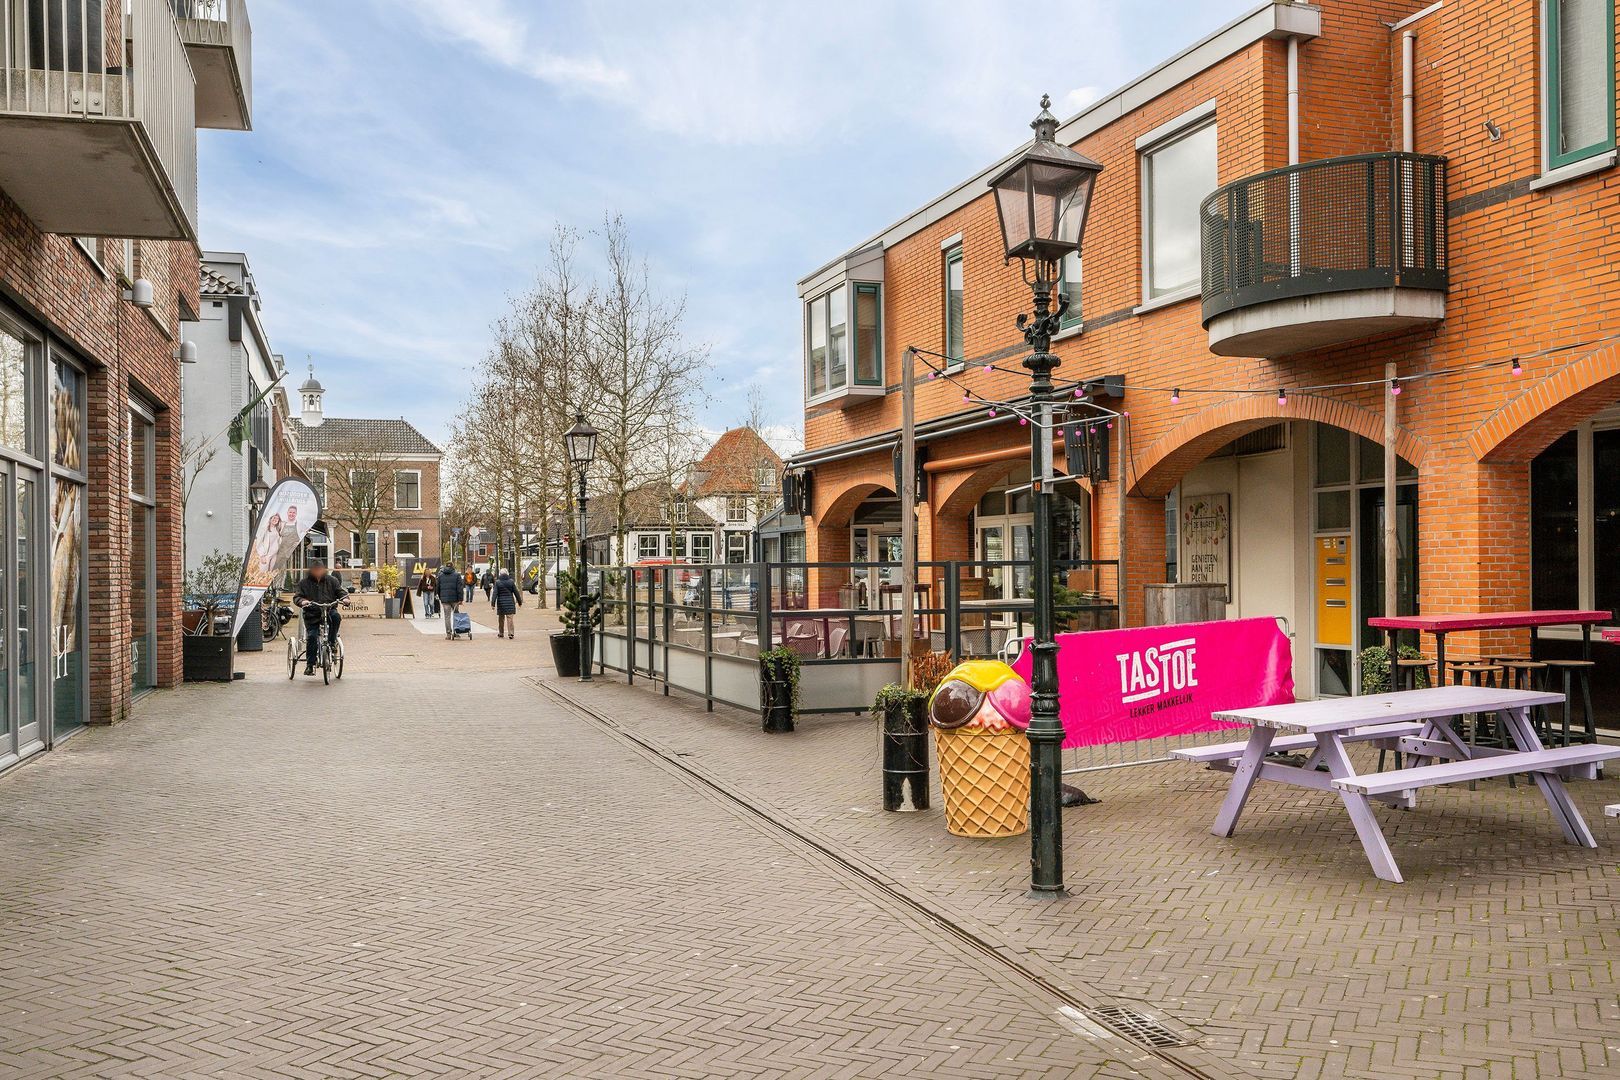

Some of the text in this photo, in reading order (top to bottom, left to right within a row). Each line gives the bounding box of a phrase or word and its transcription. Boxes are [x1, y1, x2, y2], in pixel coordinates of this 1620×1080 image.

[1191, 554, 1218, 563] GENIETEN
[1191, 564, 1215, 573] AAN HET
[1191, 574, 1208, 582] PLEIN
[1116, 646, 1198, 693] TASTOE
[1129, 703, 1155, 719] LEKKER
[1157, 693, 1194, 711] MAKKELIJK
